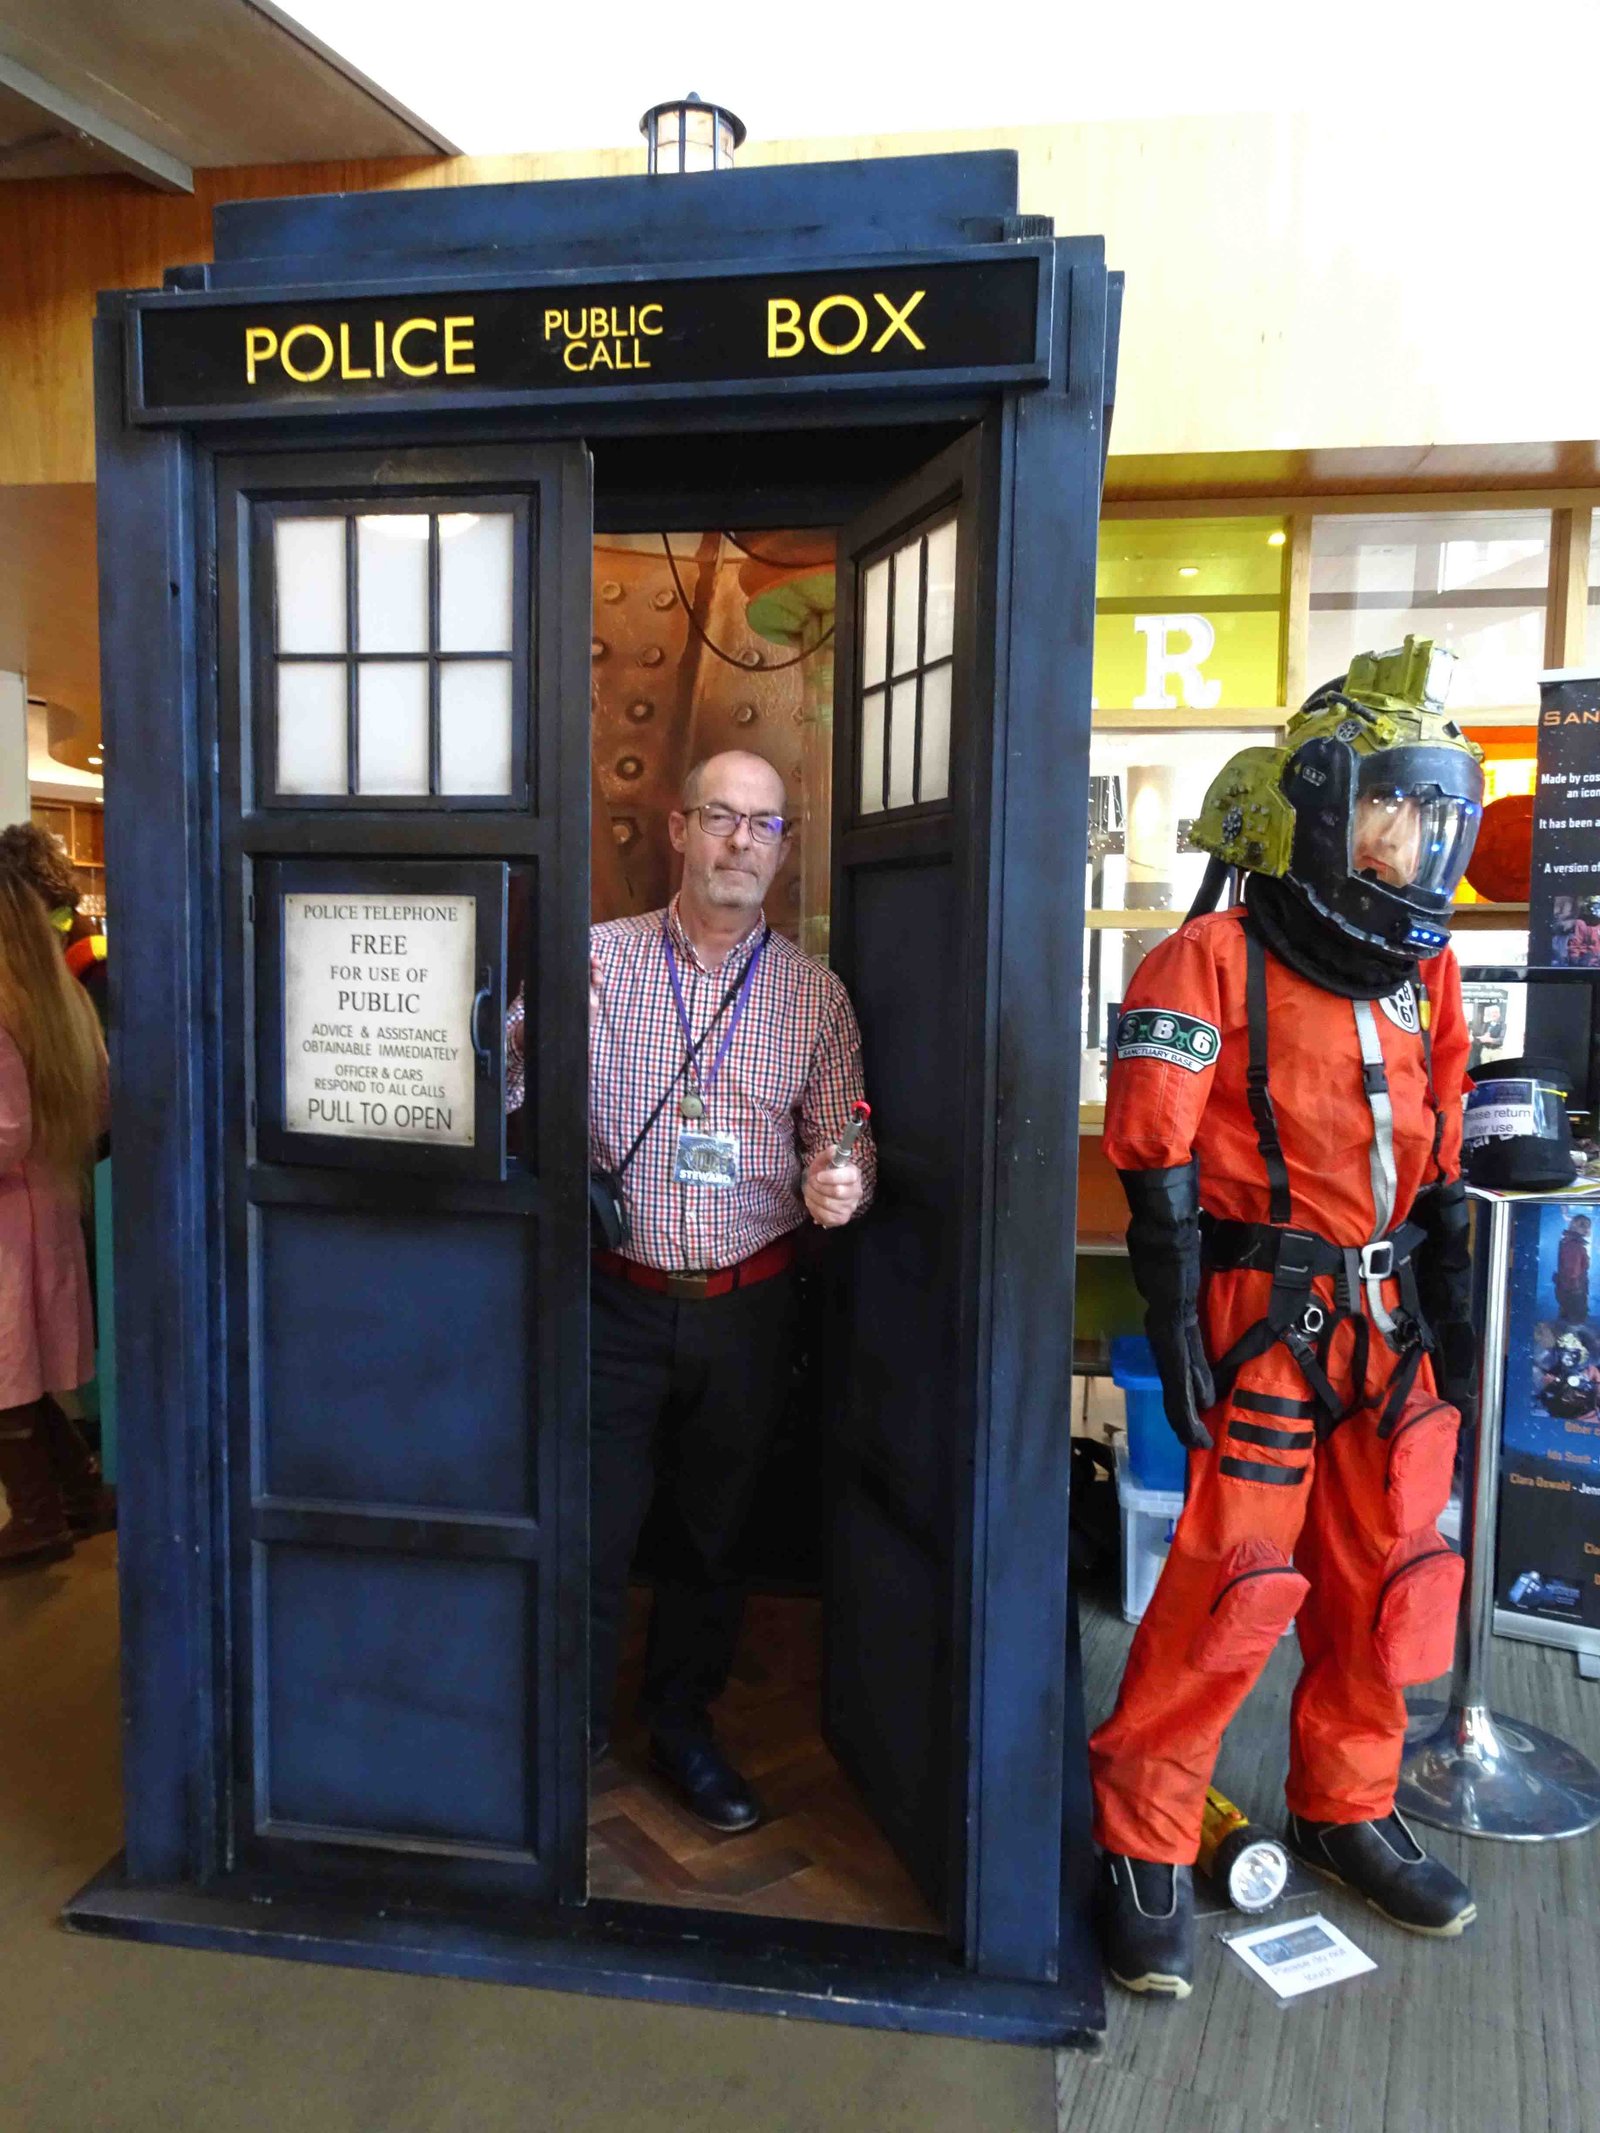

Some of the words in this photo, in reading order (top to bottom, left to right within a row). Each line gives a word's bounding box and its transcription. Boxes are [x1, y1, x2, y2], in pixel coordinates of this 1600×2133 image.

[543, 303, 664, 341] PUBLIC
[767, 290, 927, 358] BOX
[245, 315, 476, 385] POLICE
[562, 341, 651, 372] CALL
[1541, 774, 1567, 785] Made
[1569, 773, 1581, 785] by
[1567, 789, 1579, 799] an
[1539, 818, 1547, 829] It
[1549, 819, 1567, 829] has
[1569, 817, 1593, 829] been
[1544, 863, 1552, 874] A
[1554, 862, 1589, 874] version
[304, 905, 358, 920] POLICE
[363, 906, 458, 922] TELEPHONE
[351, 934, 408, 955] FREE
[330, 965, 362, 981] FOR
[369, 967, 400, 982] USE
[406, 968, 428, 983] OF
[338, 990, 420, 1014] PUBLIC
[312, 1023, 353, 1038] ADVICE
[361, 1026, 370, 1038] &
[377, 1027, 448, 1043] ASSISTANCE
[302, 1040, 372, 1057] OBTAINABLE
[379, 1044, 459, 1061] IMMEDIATELY
[1123, 1047, 1168, 1058] SANCTUARY
[1171, 1054, 1193, 1068] BASE
[335, 1064, 378, 1079] OFFICER
[381, 1067, 390, 1079] &
[393, 1068, 423, 1082] CARS
[315, 1078, 366, 1094] RESPOND
[370, 1082, 385, 1095] TO
[389, 1084, 407, 1096] ALL
[411, 1085, 446, 1099] CALLS
[308, 1098, 355, 1124] PULL
[360, 1102, 387, 1126] TO
[394, 1104, 452, 1131] OPEN
[1494, 1108, 1531, 1118] return
[1491, 1124, 1518, 1133] use.
